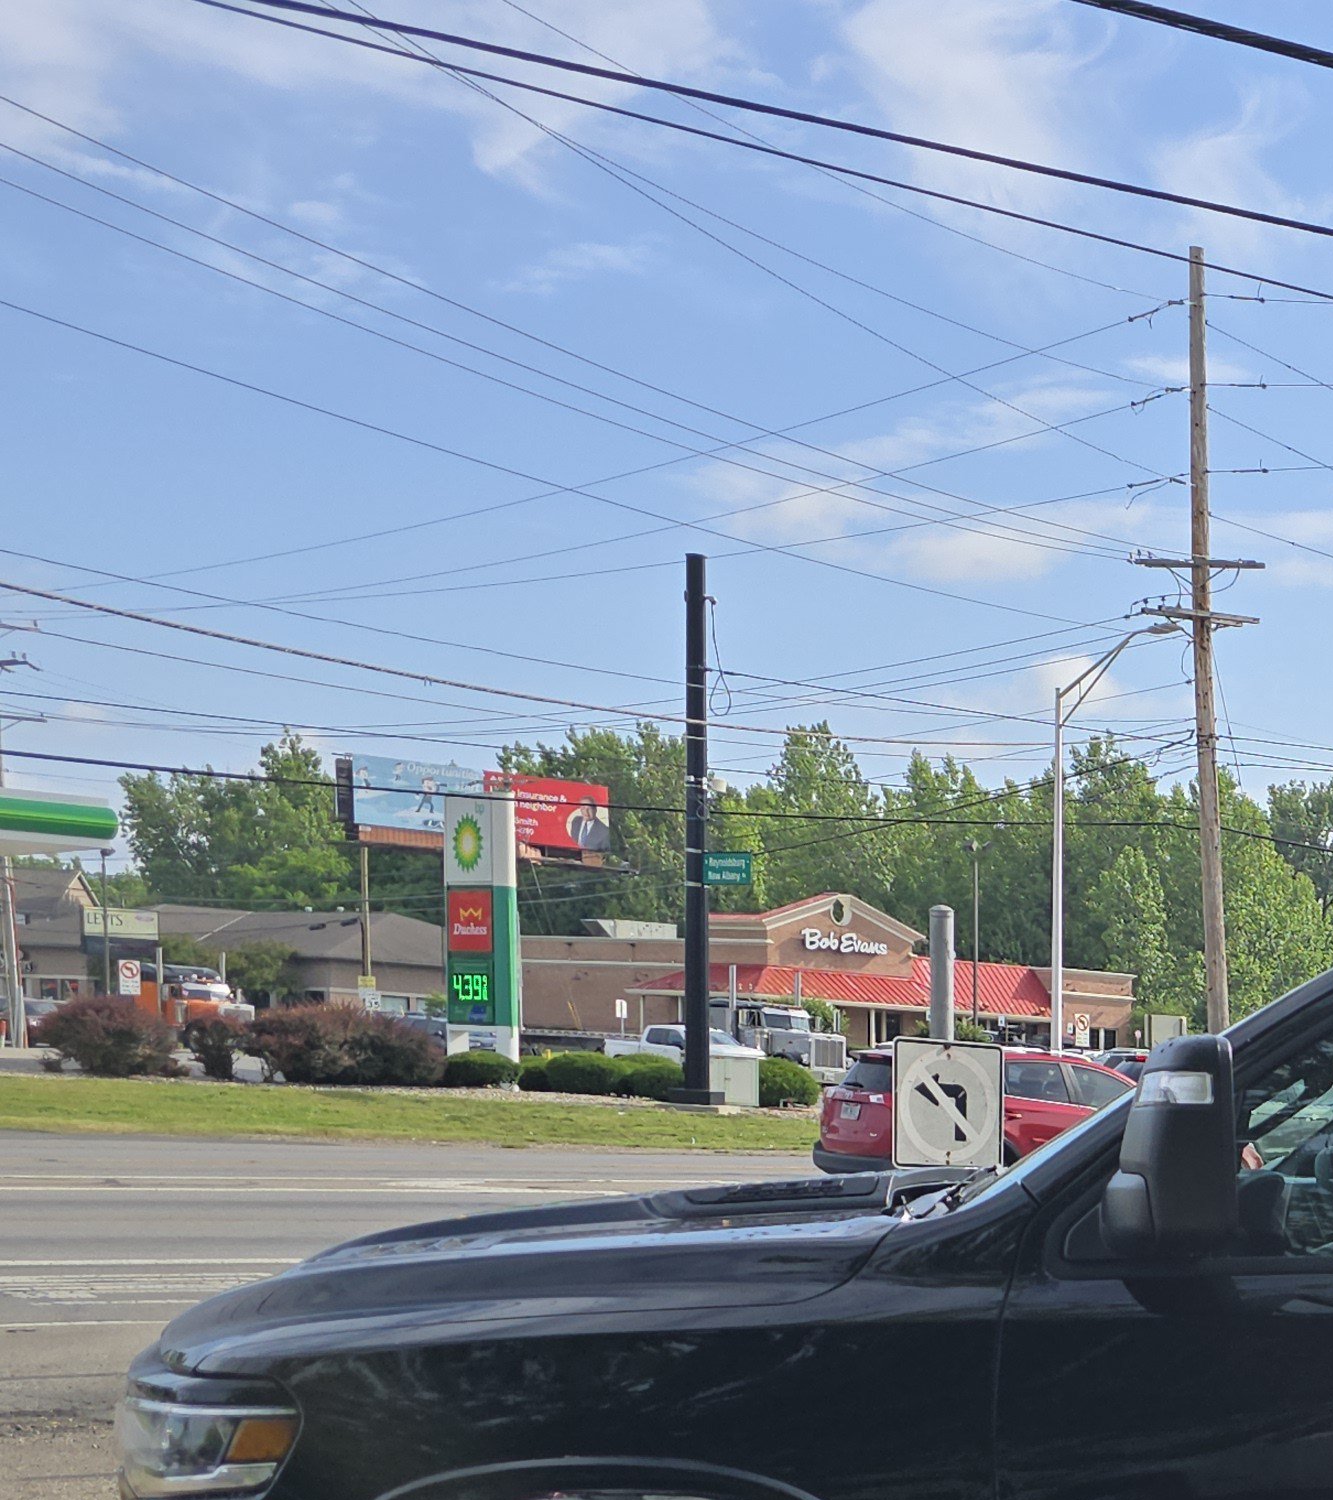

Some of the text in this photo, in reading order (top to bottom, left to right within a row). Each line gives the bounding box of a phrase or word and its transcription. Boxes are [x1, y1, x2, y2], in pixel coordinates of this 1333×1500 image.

[474, 801, 485, 815] bp
[452, 922, 488, 936] Duchess
[801, 927, 888, 955] Bob Evans
